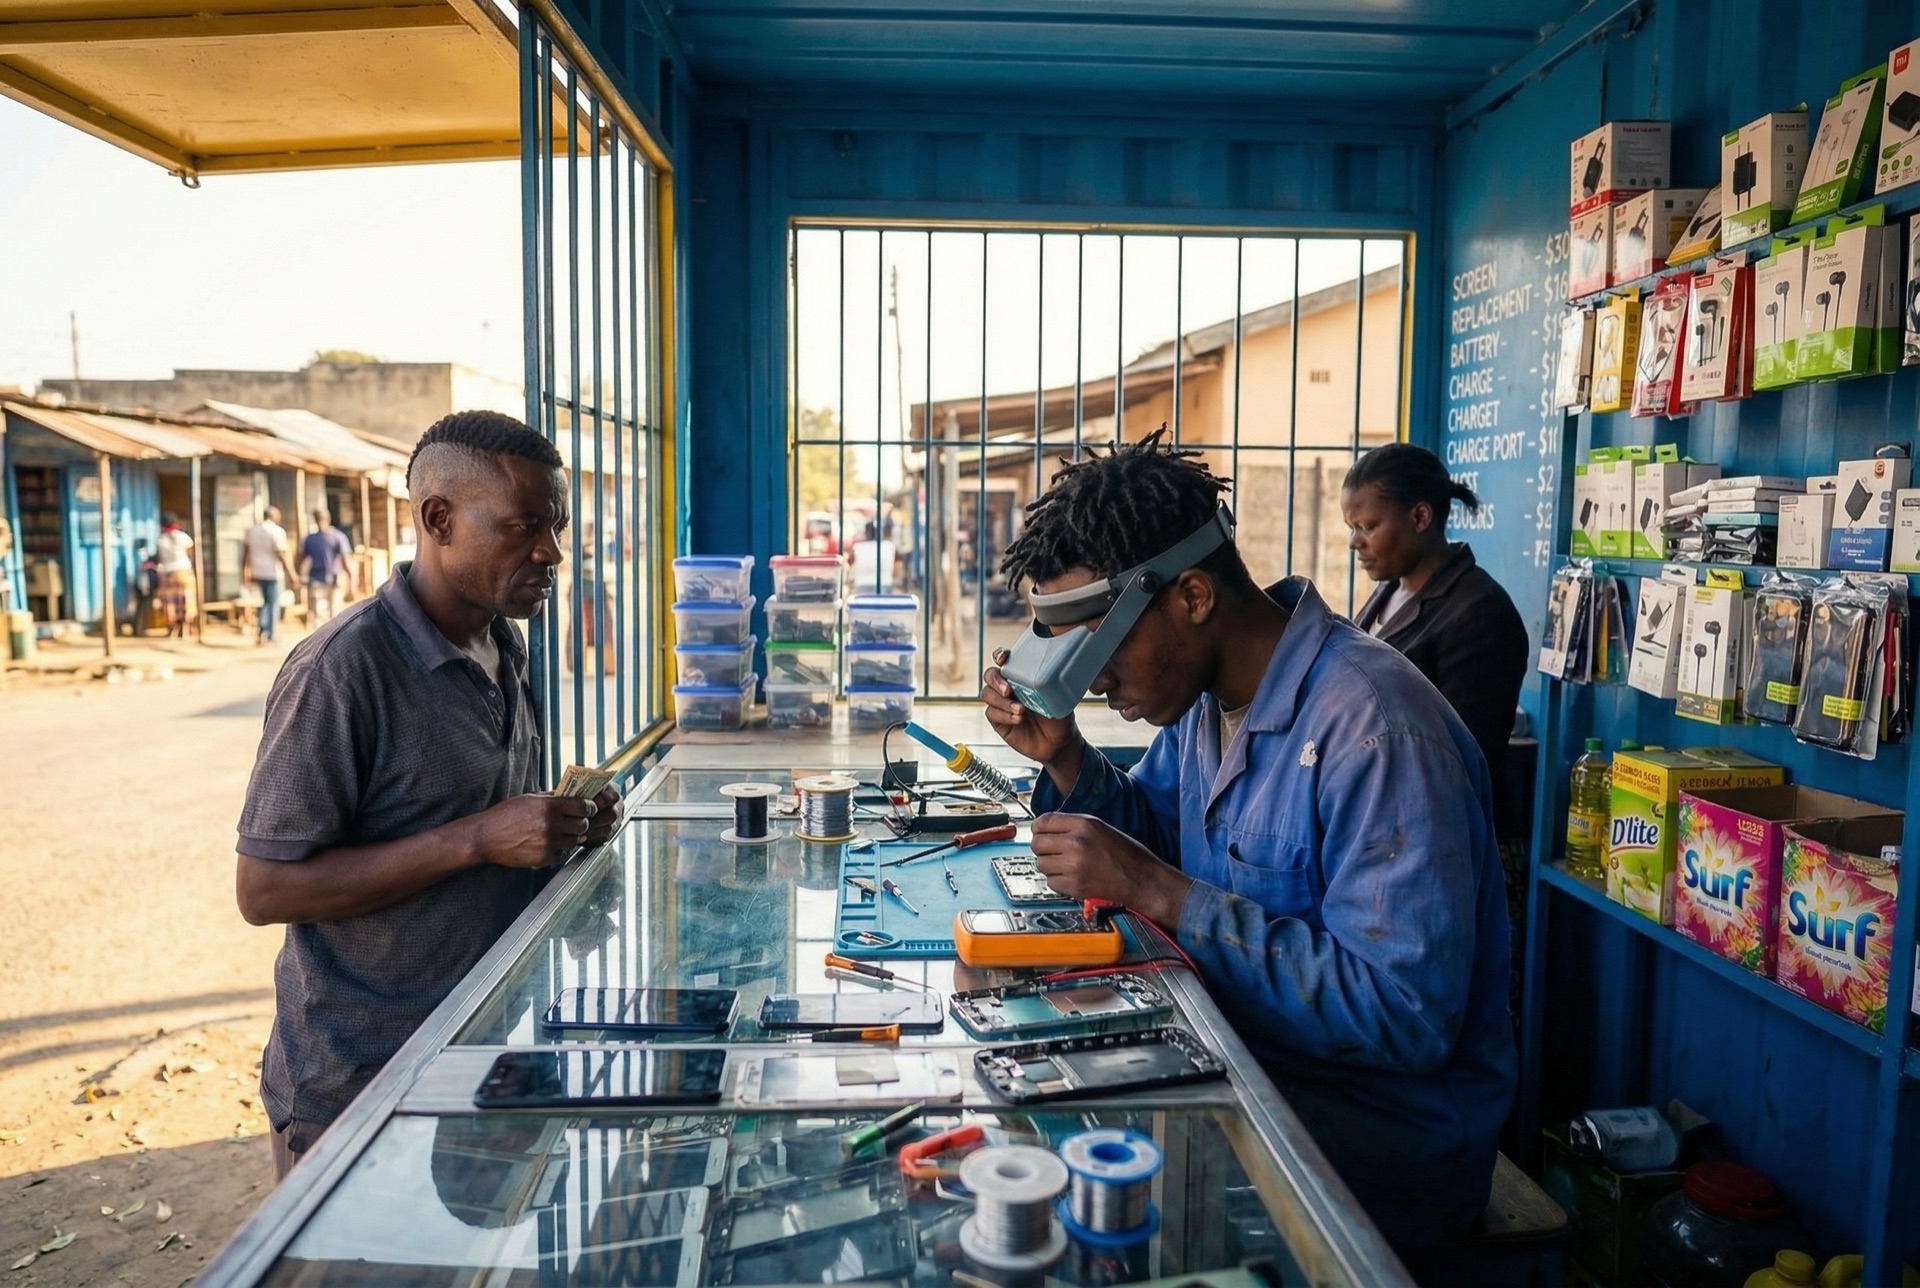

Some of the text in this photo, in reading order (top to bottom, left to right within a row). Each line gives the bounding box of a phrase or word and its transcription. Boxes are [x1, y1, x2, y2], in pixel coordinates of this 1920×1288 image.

[1453, 261, 1497, 301] SCREEN
[1545, 230, 1570, 268] $30
[1452, 284, 1532, 335] REPLACEMENT
[1543, 270, 1568, 307] $16
[1449, 367, 1494, 400] CHARGE
[1541, 349, 1559, 385] $1
[1448, 400, 1500, 433] CHARGET
[1540, 388, 1559, 421] $1
[1446, 436, 1490, 465] CHARGE
[1493, 431, 1525, 461] PORT
[1612, 816, 1659, 845] D'lite
[1684, 849, 1754, 910] Surf
[1787, 890, 1881, 961] Surf
